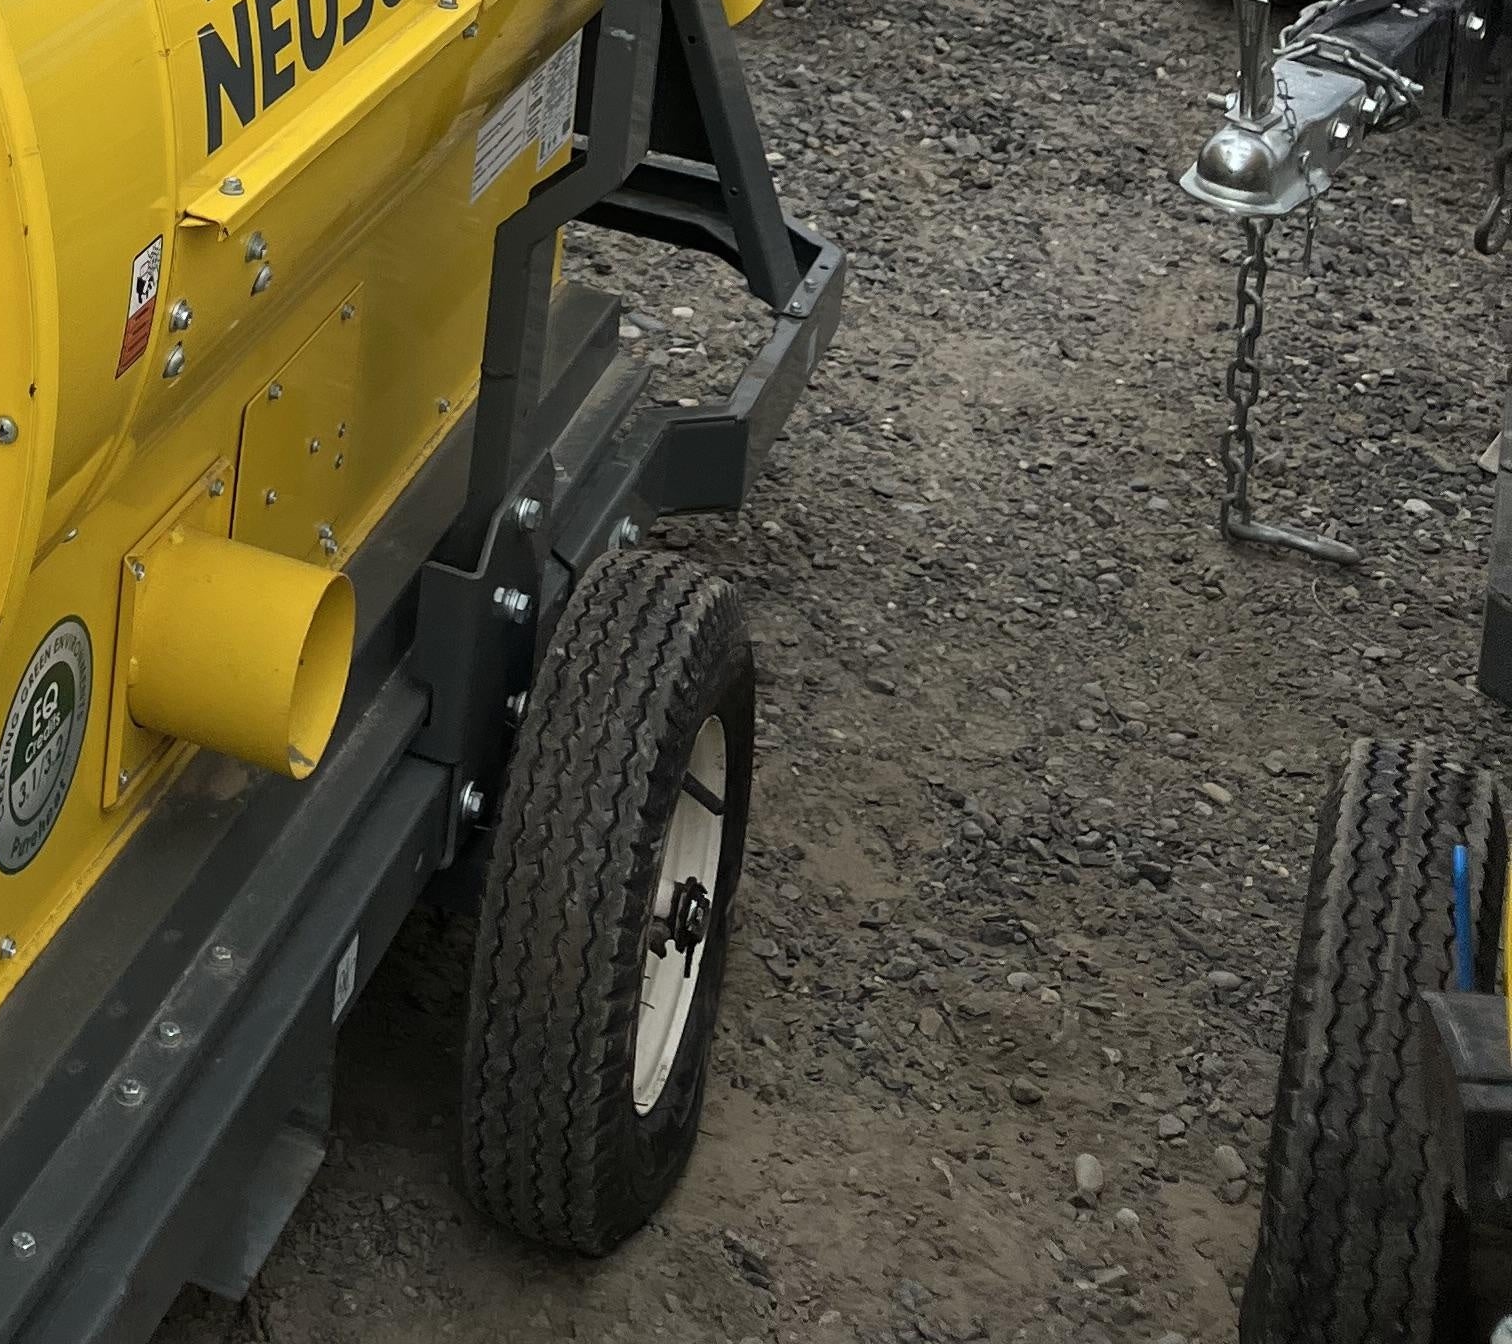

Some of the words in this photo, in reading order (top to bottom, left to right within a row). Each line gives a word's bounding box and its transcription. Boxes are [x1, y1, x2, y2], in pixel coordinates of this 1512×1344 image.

[20, 645, 52, 705] GREEN
[31, 680, 60, 737] EQ
[24, 712, 62, 764] Credits
